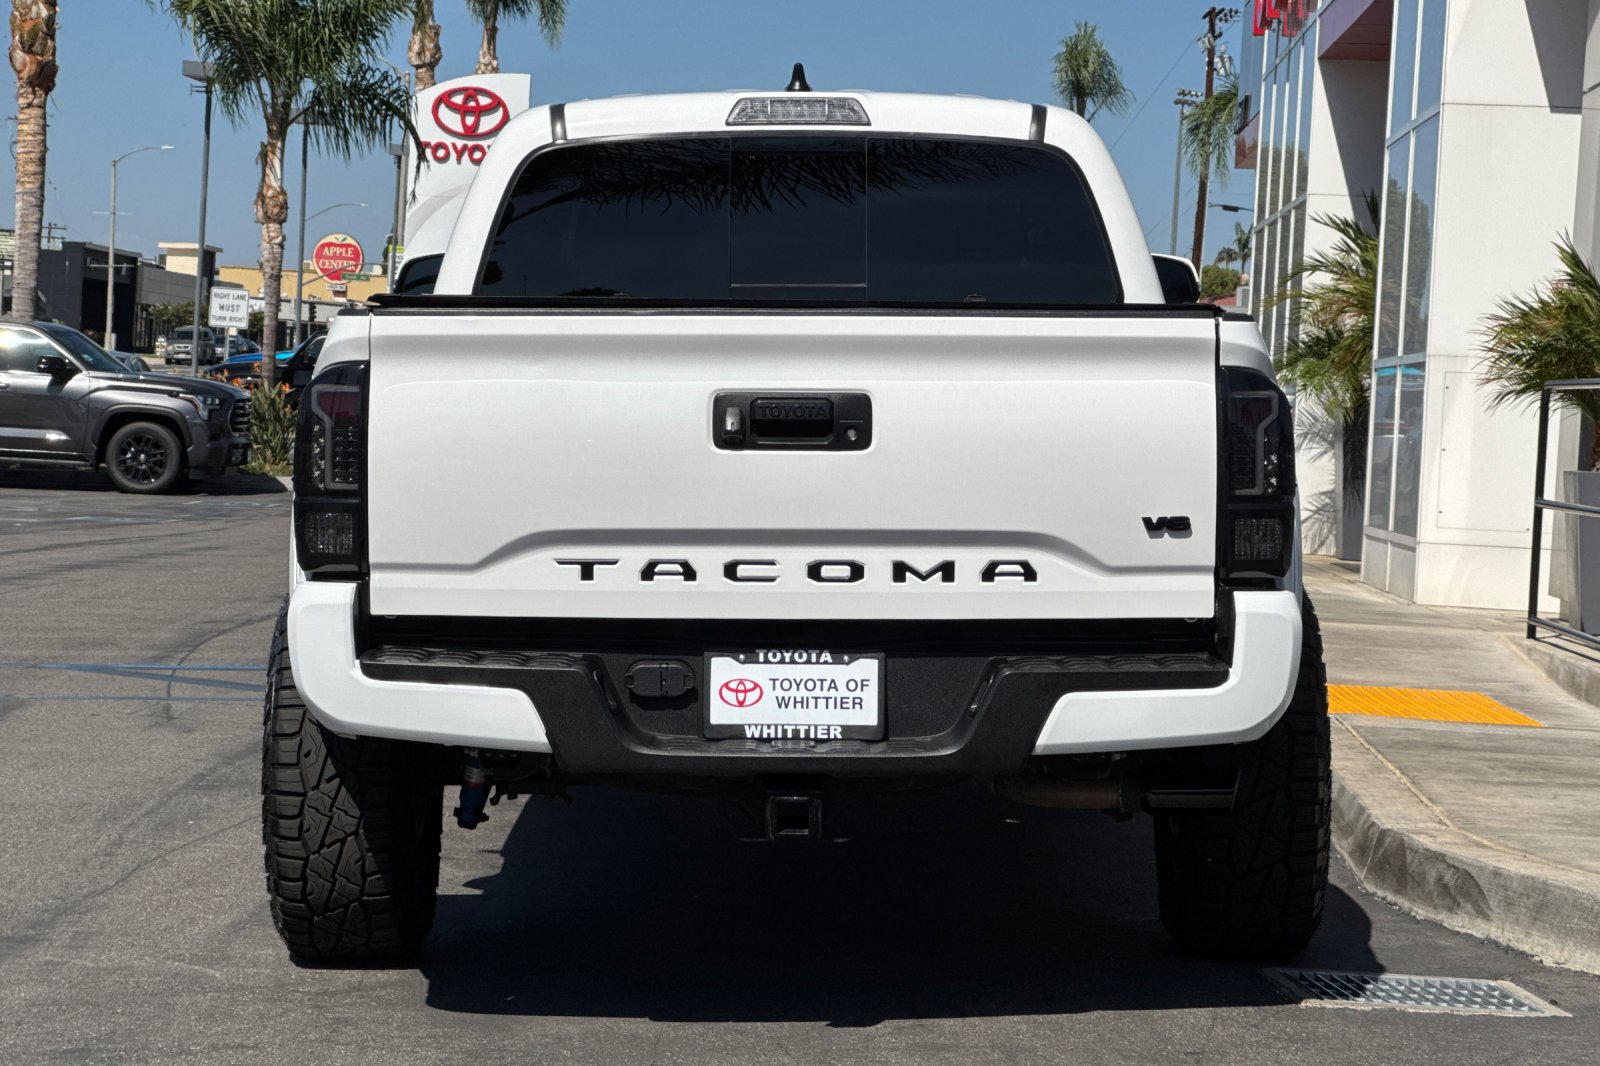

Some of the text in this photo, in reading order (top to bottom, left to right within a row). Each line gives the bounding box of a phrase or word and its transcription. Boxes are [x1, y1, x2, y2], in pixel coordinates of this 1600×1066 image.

[420, 141, 491, 163] TOYO
[323, 246, 354, 257] APPLE
[319, 259, 356, 271] CENTER
[213, 292, 247, 301] RIGHT LANE
[219, 303, 240, 312] MUST
[212, 314, 246, 323] TURN RIGHT
[758, 404, 827, 418] TOYOTA
[1141, 516, 1192, 539] V6
[554, 558, 1039, 584] TACOMA
[755, 649, 833, 663] TOYOTA
[769, 678, 871, 692] TOYOTA OF
[775, 696, 864, 710] WHITTIER
[744, 725, 843, 739] WHITTIER
